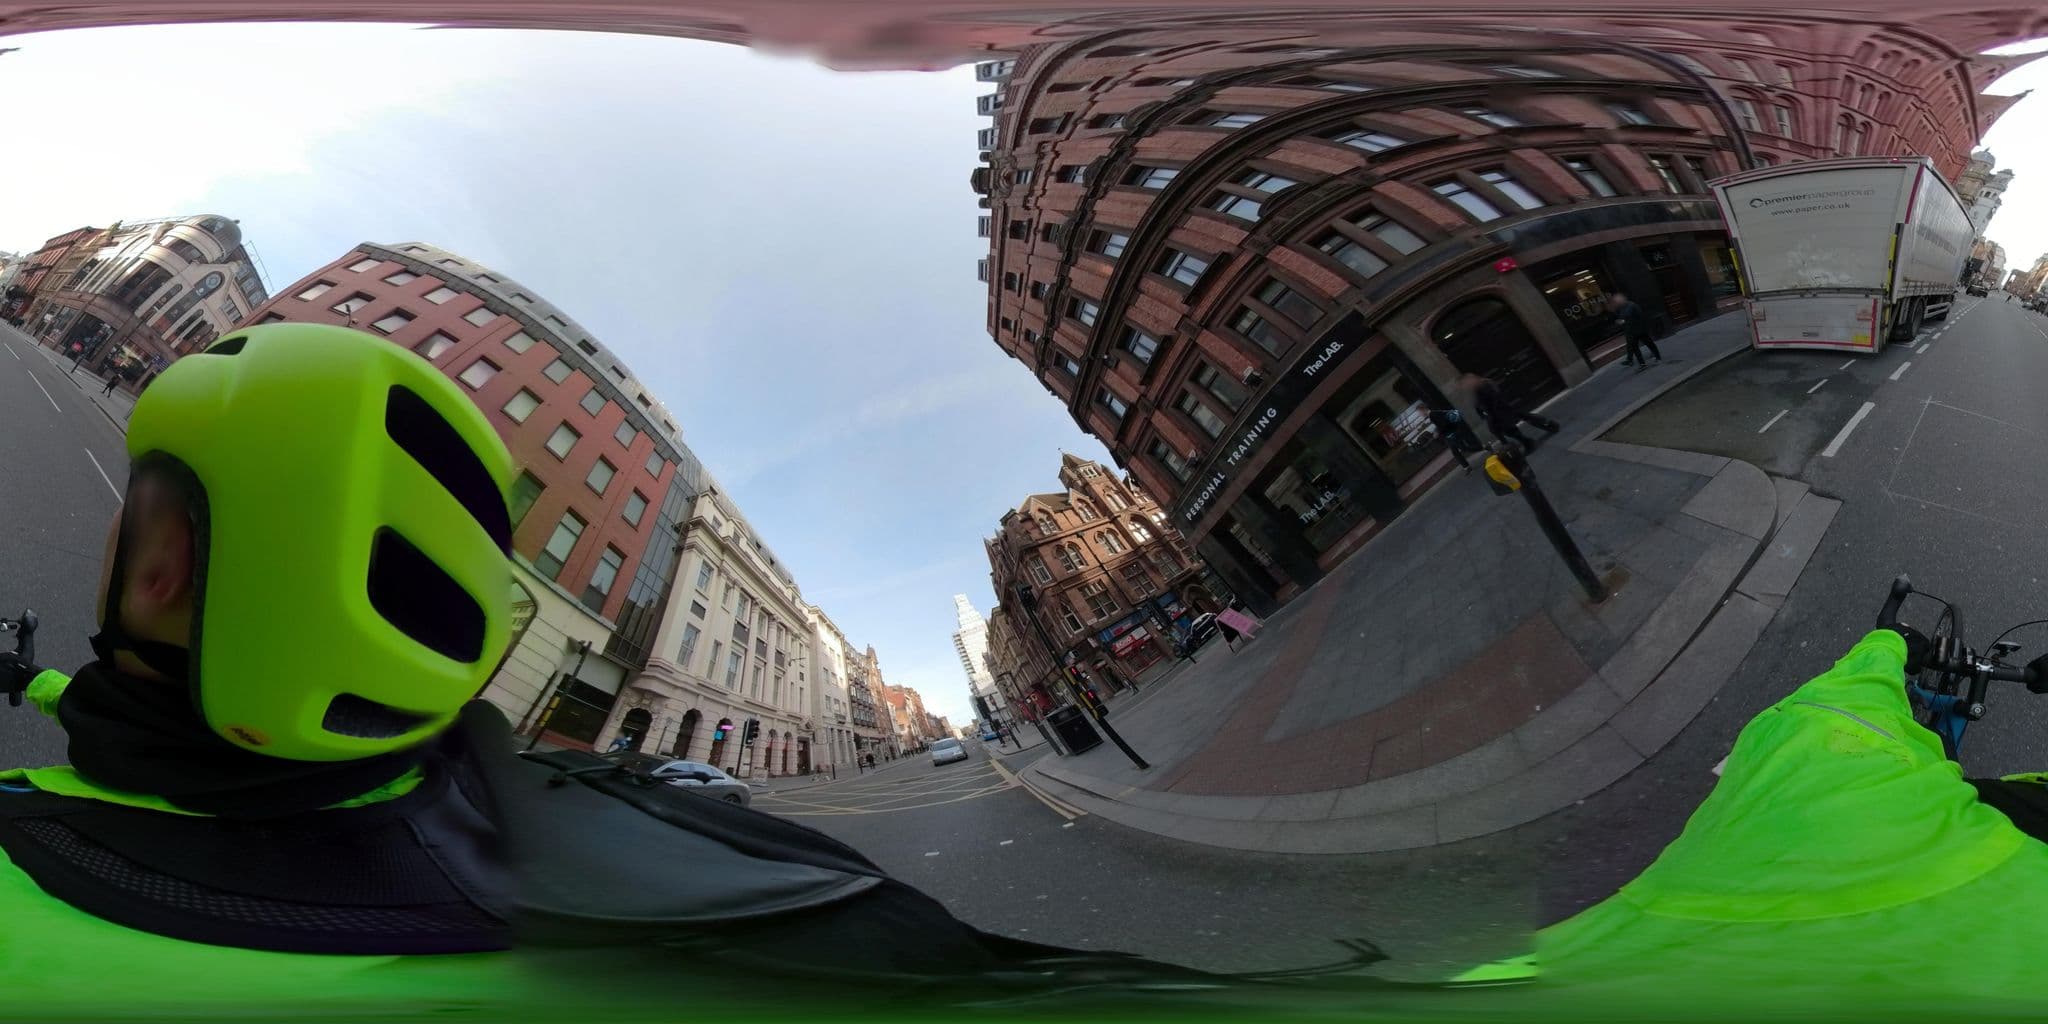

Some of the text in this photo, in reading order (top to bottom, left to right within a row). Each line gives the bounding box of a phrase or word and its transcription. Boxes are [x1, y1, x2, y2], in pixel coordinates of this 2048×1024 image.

[1764, 189, 1875, 206] premierpapergroup
[1771, 202, 1851, 217] www.paper.co.uk
[1303, 358, 1325, 378] The
[1185, 407, 1278, 521] PERSONAL TRAINING
[1299, 506, 1318, 524] The
